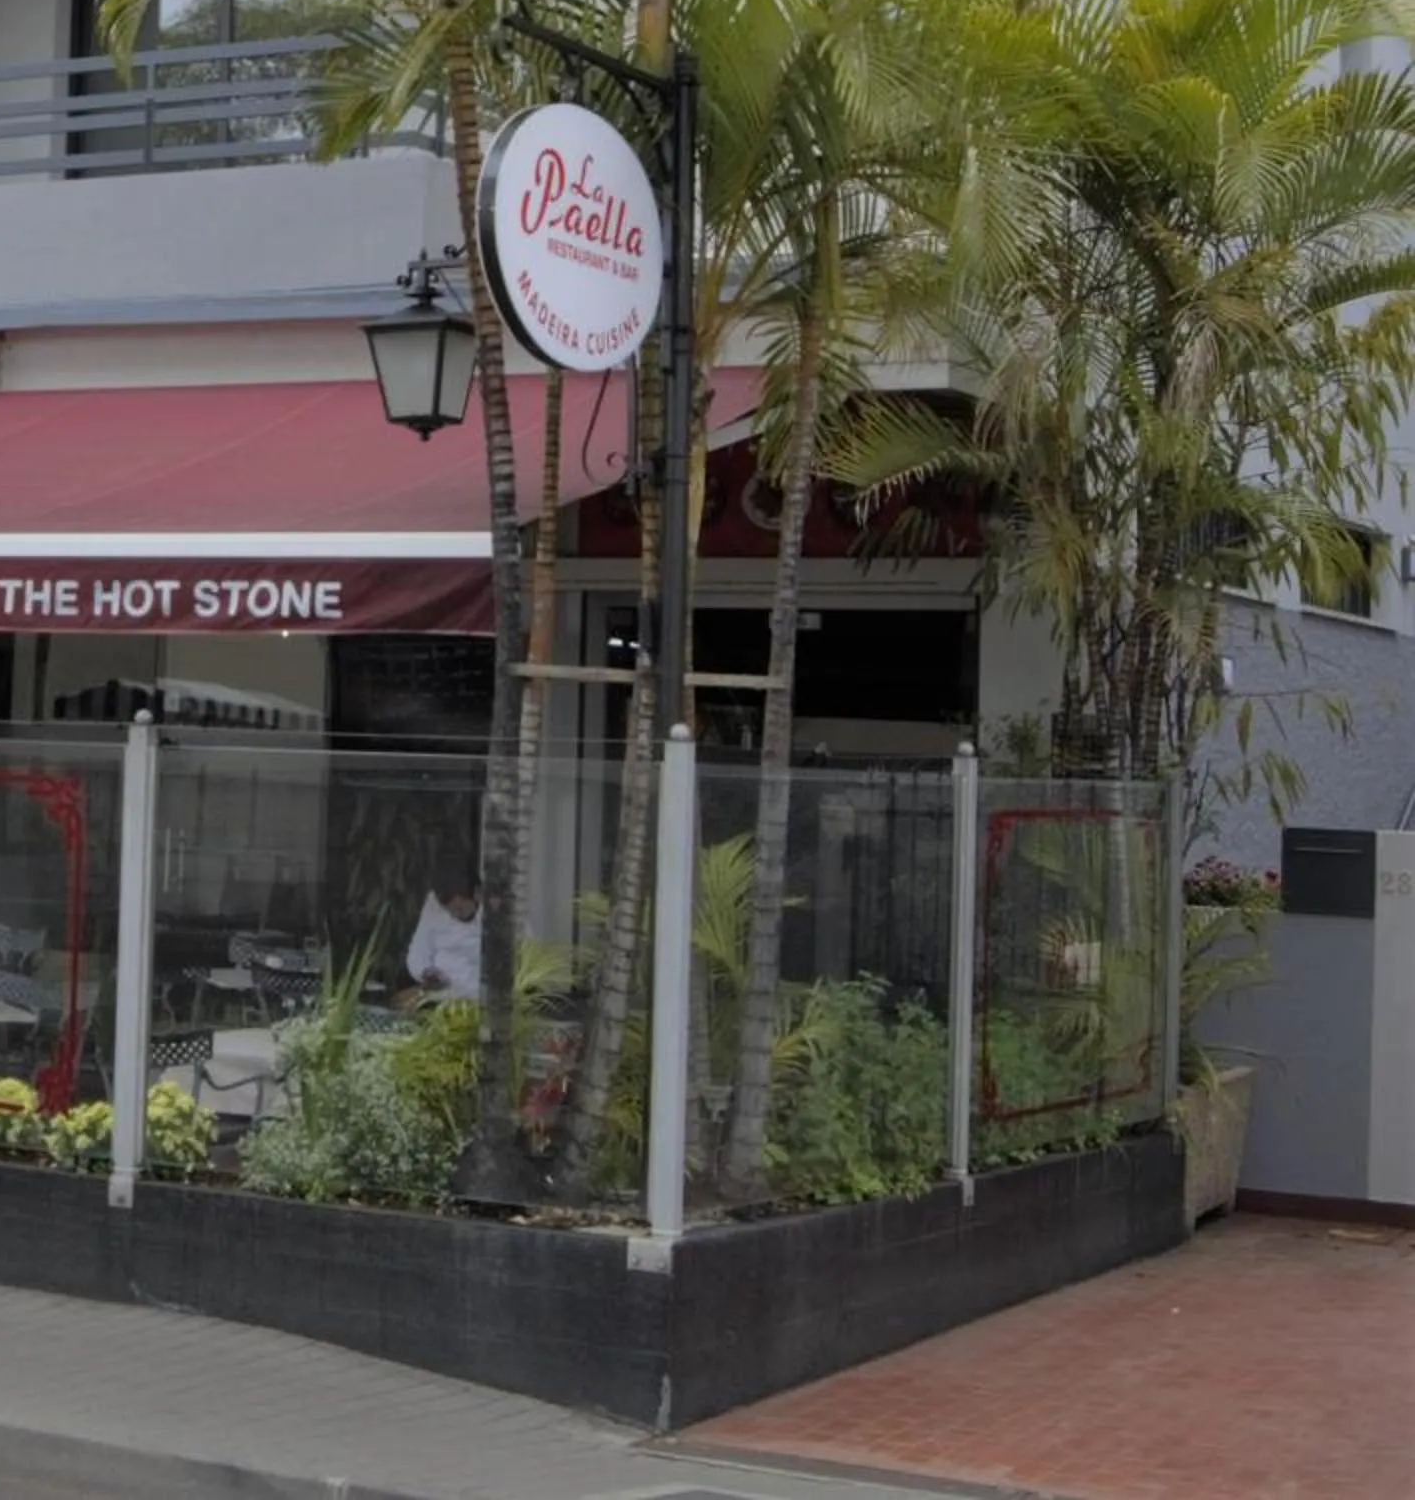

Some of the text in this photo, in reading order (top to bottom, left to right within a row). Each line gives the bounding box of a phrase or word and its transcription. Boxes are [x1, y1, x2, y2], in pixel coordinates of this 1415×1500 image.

[520, 147, 647, 258] Paella
[570, 153, 605, 204] La
[546, 237, 610, 272] RESTAURANT
[619, 261, 641, 281] BAR
[517, 269, 642, 356] MADEIRA CUISINE
[93, 580, 181, 618] HOT
[193, 580, 343, 619] STONE
